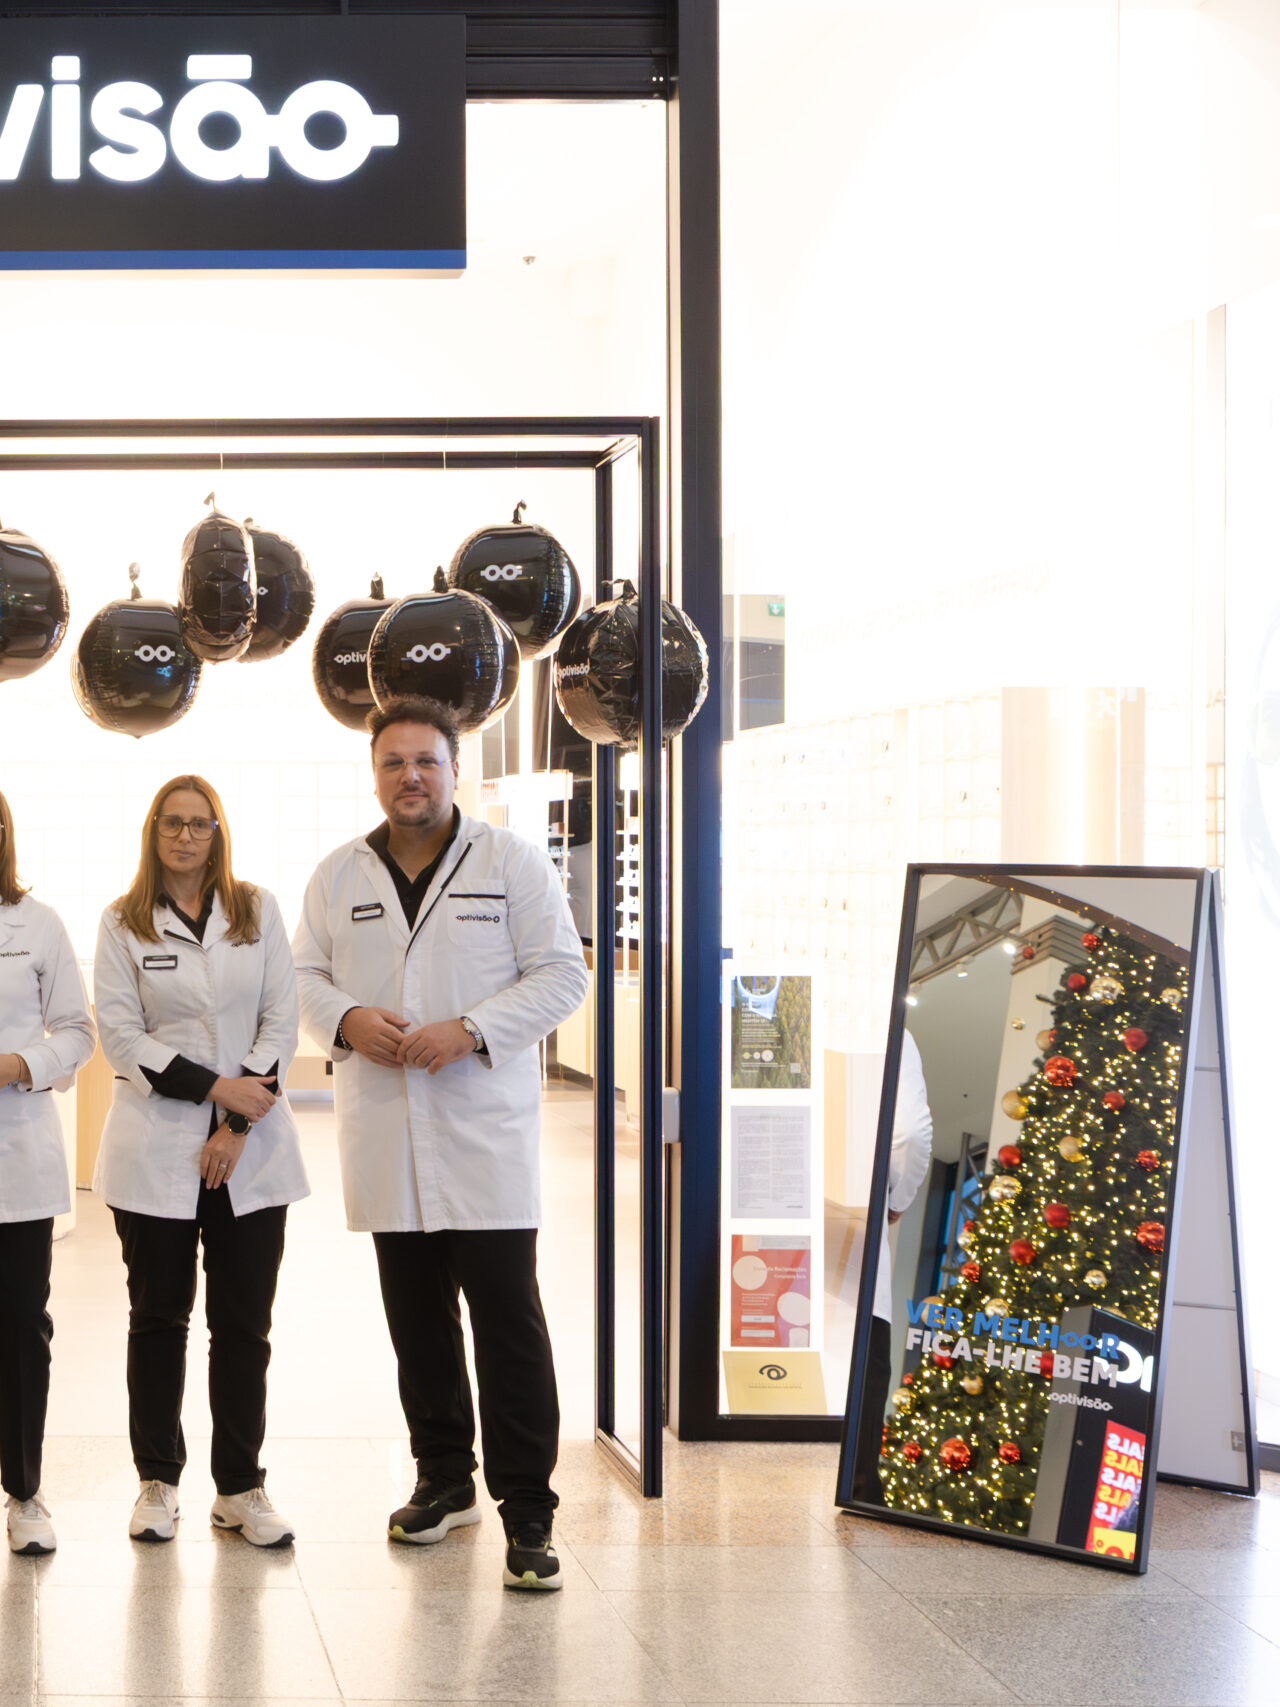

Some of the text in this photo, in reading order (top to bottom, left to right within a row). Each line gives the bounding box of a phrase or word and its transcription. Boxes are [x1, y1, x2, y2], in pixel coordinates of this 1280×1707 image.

[333, 651, 368, 665] optiv
[905, 1299, 965, 1332] VER
[905, 1327, 1043, 1376] FICA-LHE
[1052, 1354, 1120, 1388] BEM
[1048, 1391, 1113, 1412] optivisão
